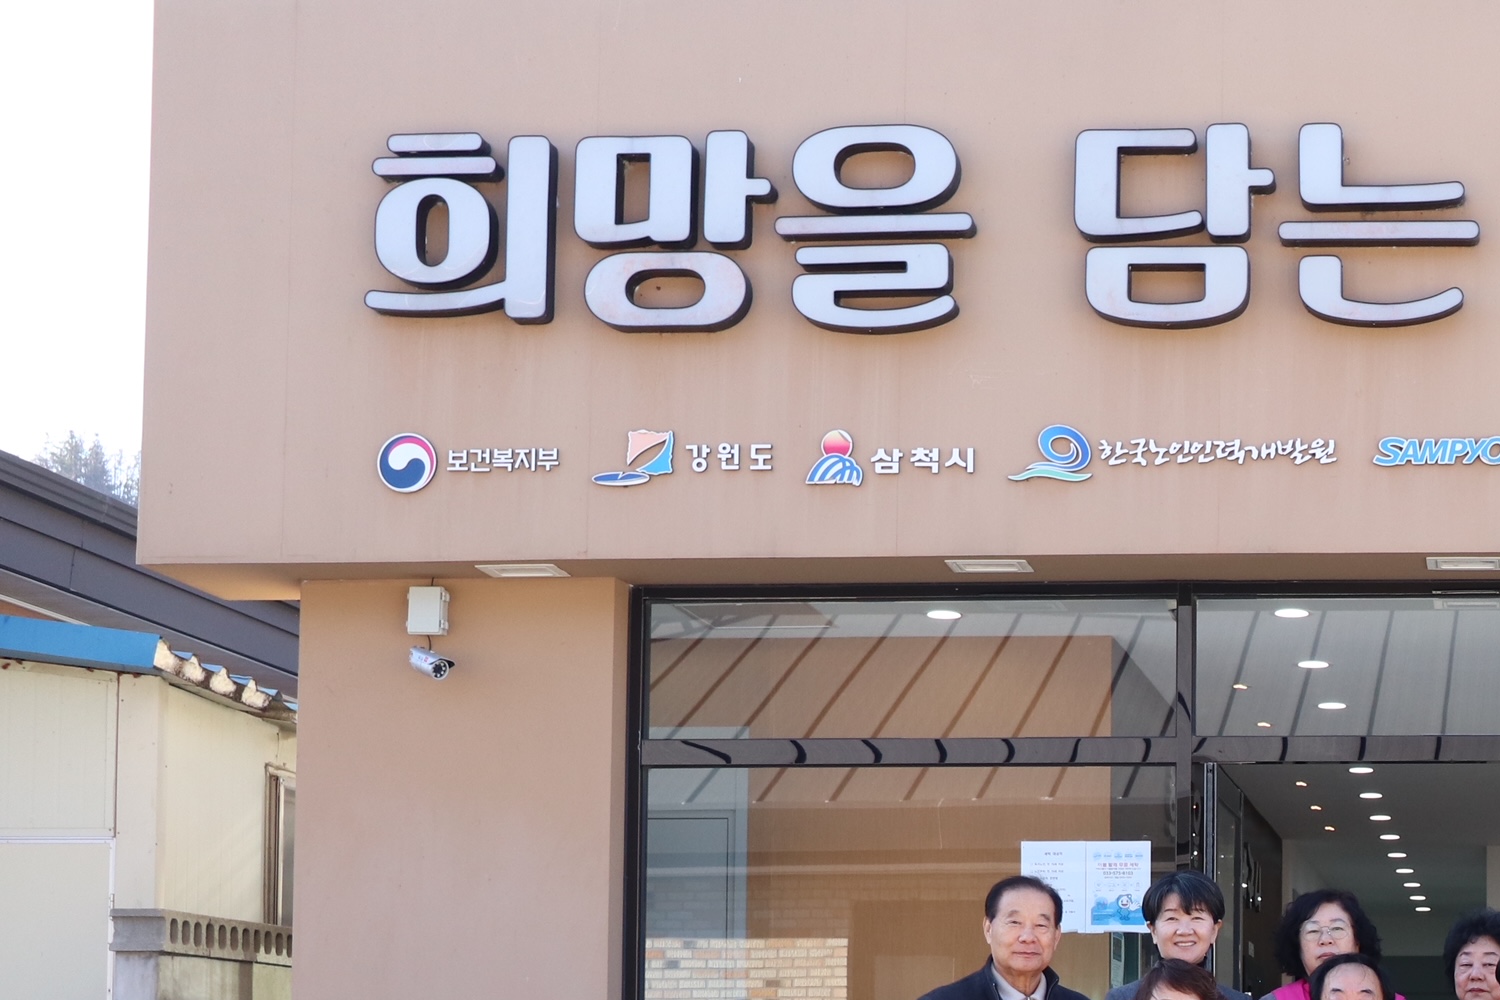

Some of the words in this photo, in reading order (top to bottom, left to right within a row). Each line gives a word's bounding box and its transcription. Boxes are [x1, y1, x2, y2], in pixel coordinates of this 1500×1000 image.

[364, 123, 979, 335] 희망을
[1074, 122, 1482, 331] 담는
[446, 446, 561, 473] 보건복지부
[684, 442, 774, 472] 강원도
[870, 445, 977, 475] 삼척시
[1098, 437, 1338, 466] 한국노인인력개발원
